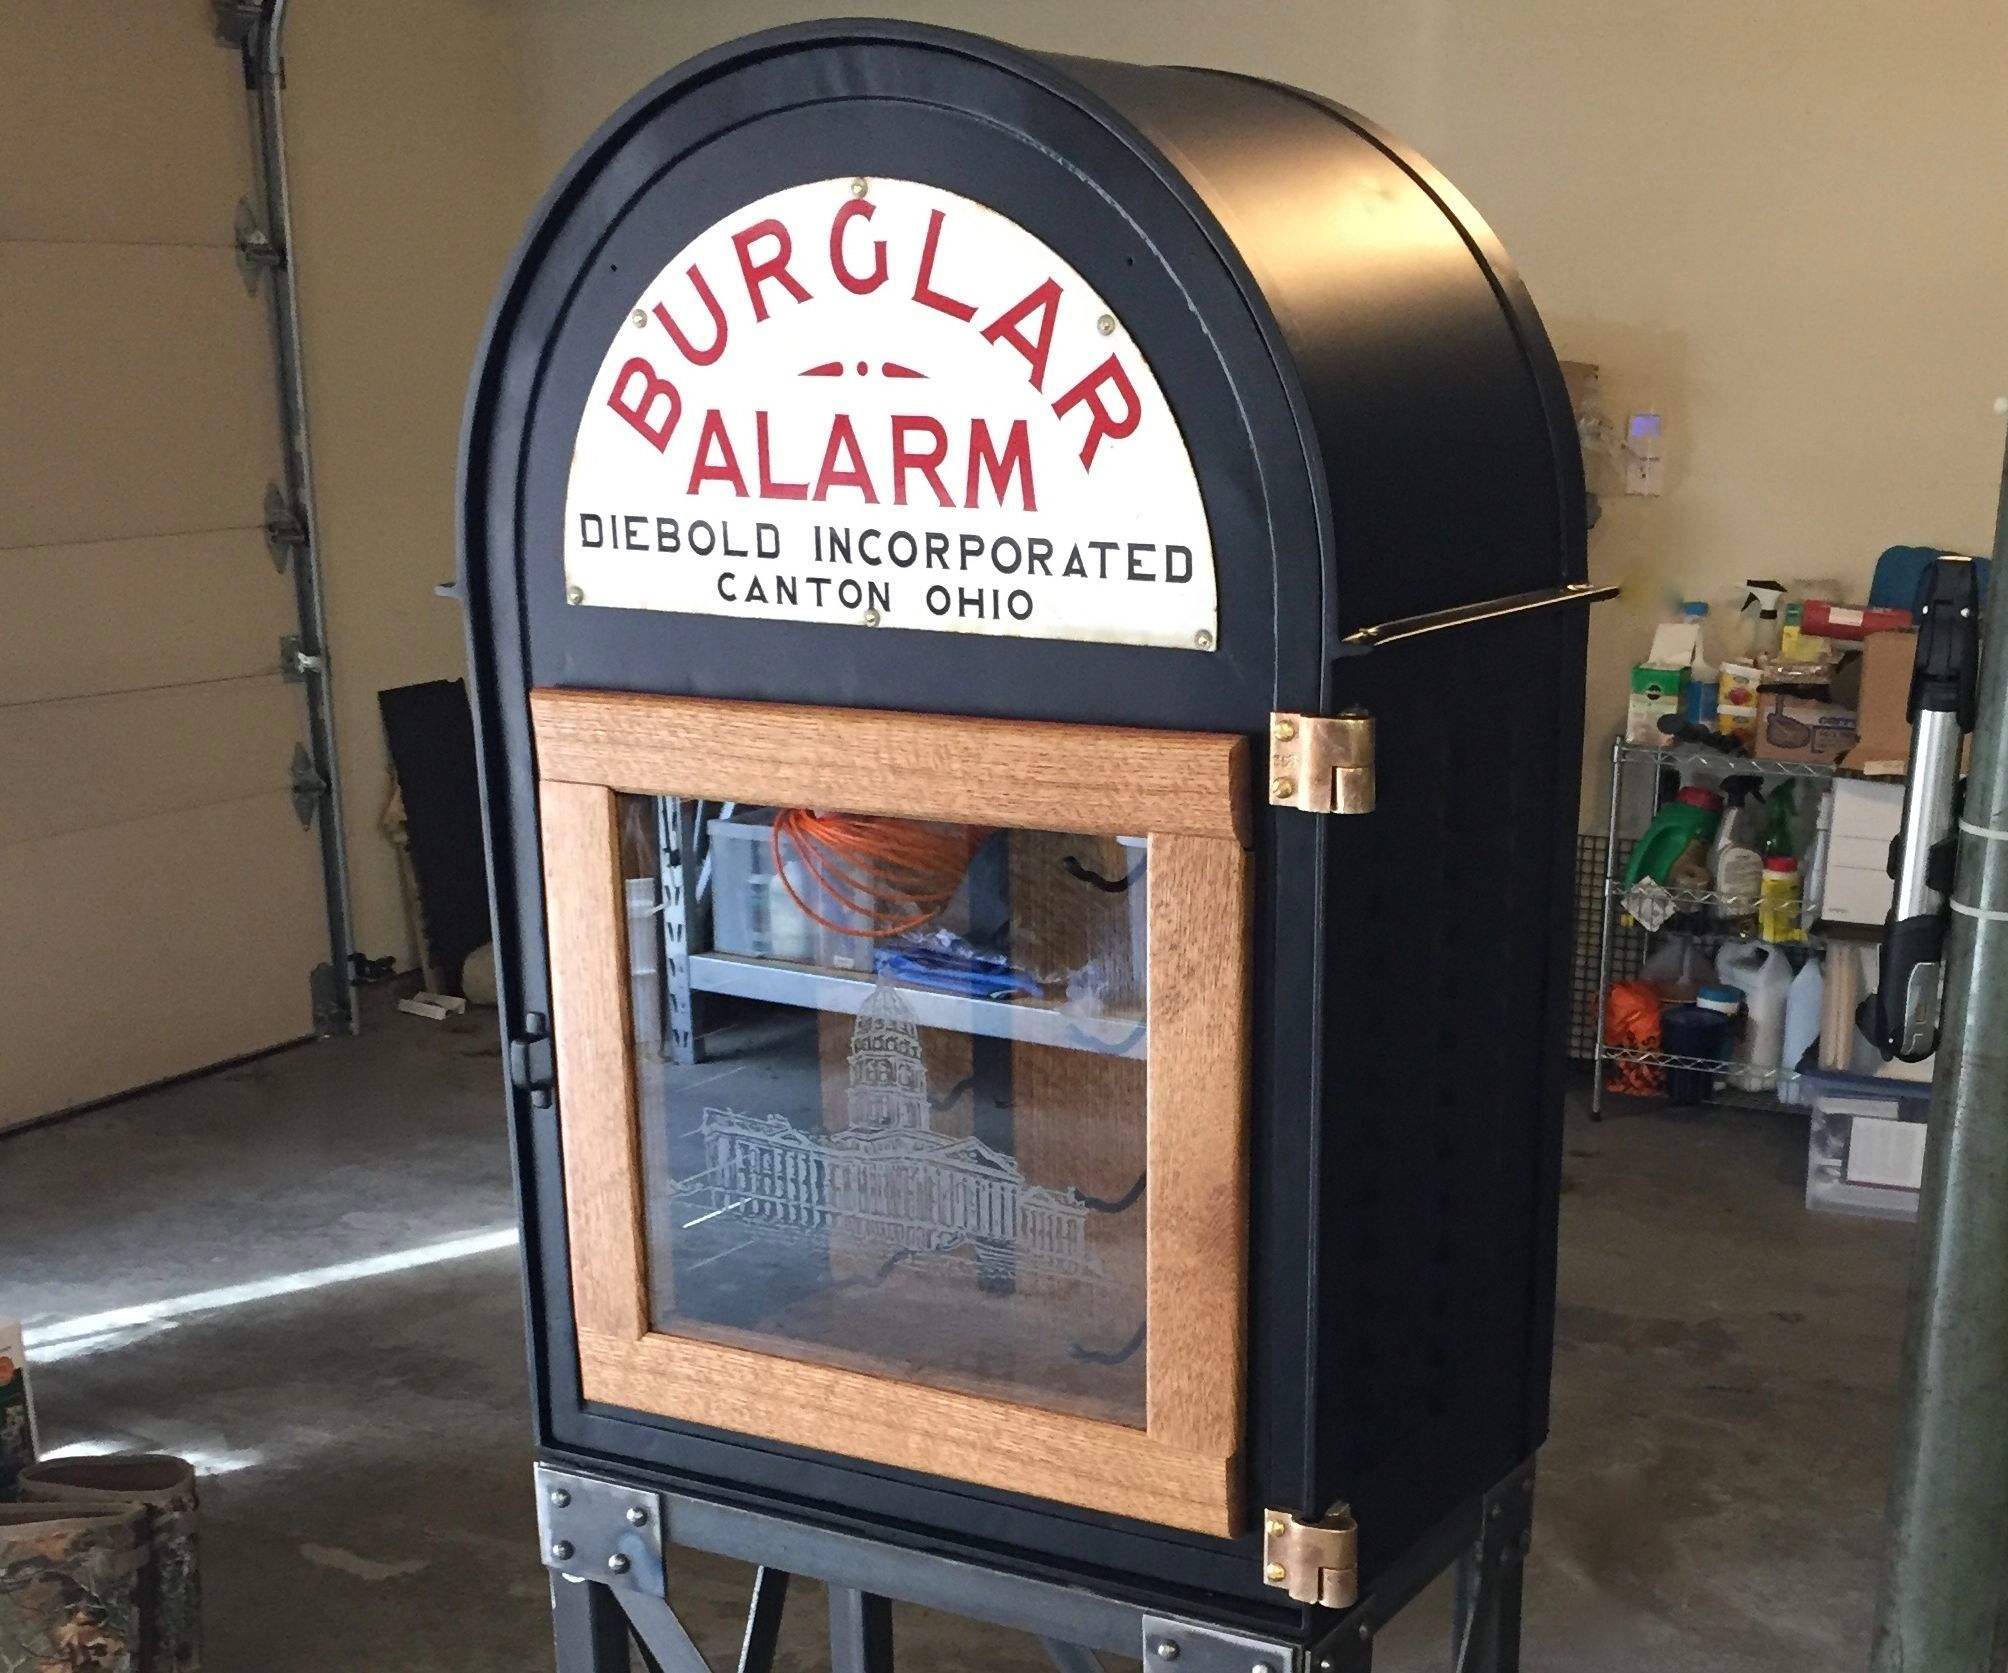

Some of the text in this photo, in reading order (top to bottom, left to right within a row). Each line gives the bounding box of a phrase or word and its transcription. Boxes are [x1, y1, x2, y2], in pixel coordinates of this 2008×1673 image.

[606, 197, 1142, 474] BURGLAR
[687, 408, 1038, 512] ALARM
[579, 513, 1194, 584] DIEBOLD INCORPORATED
[717, 572, 1034, 621] CANTON OHIO
